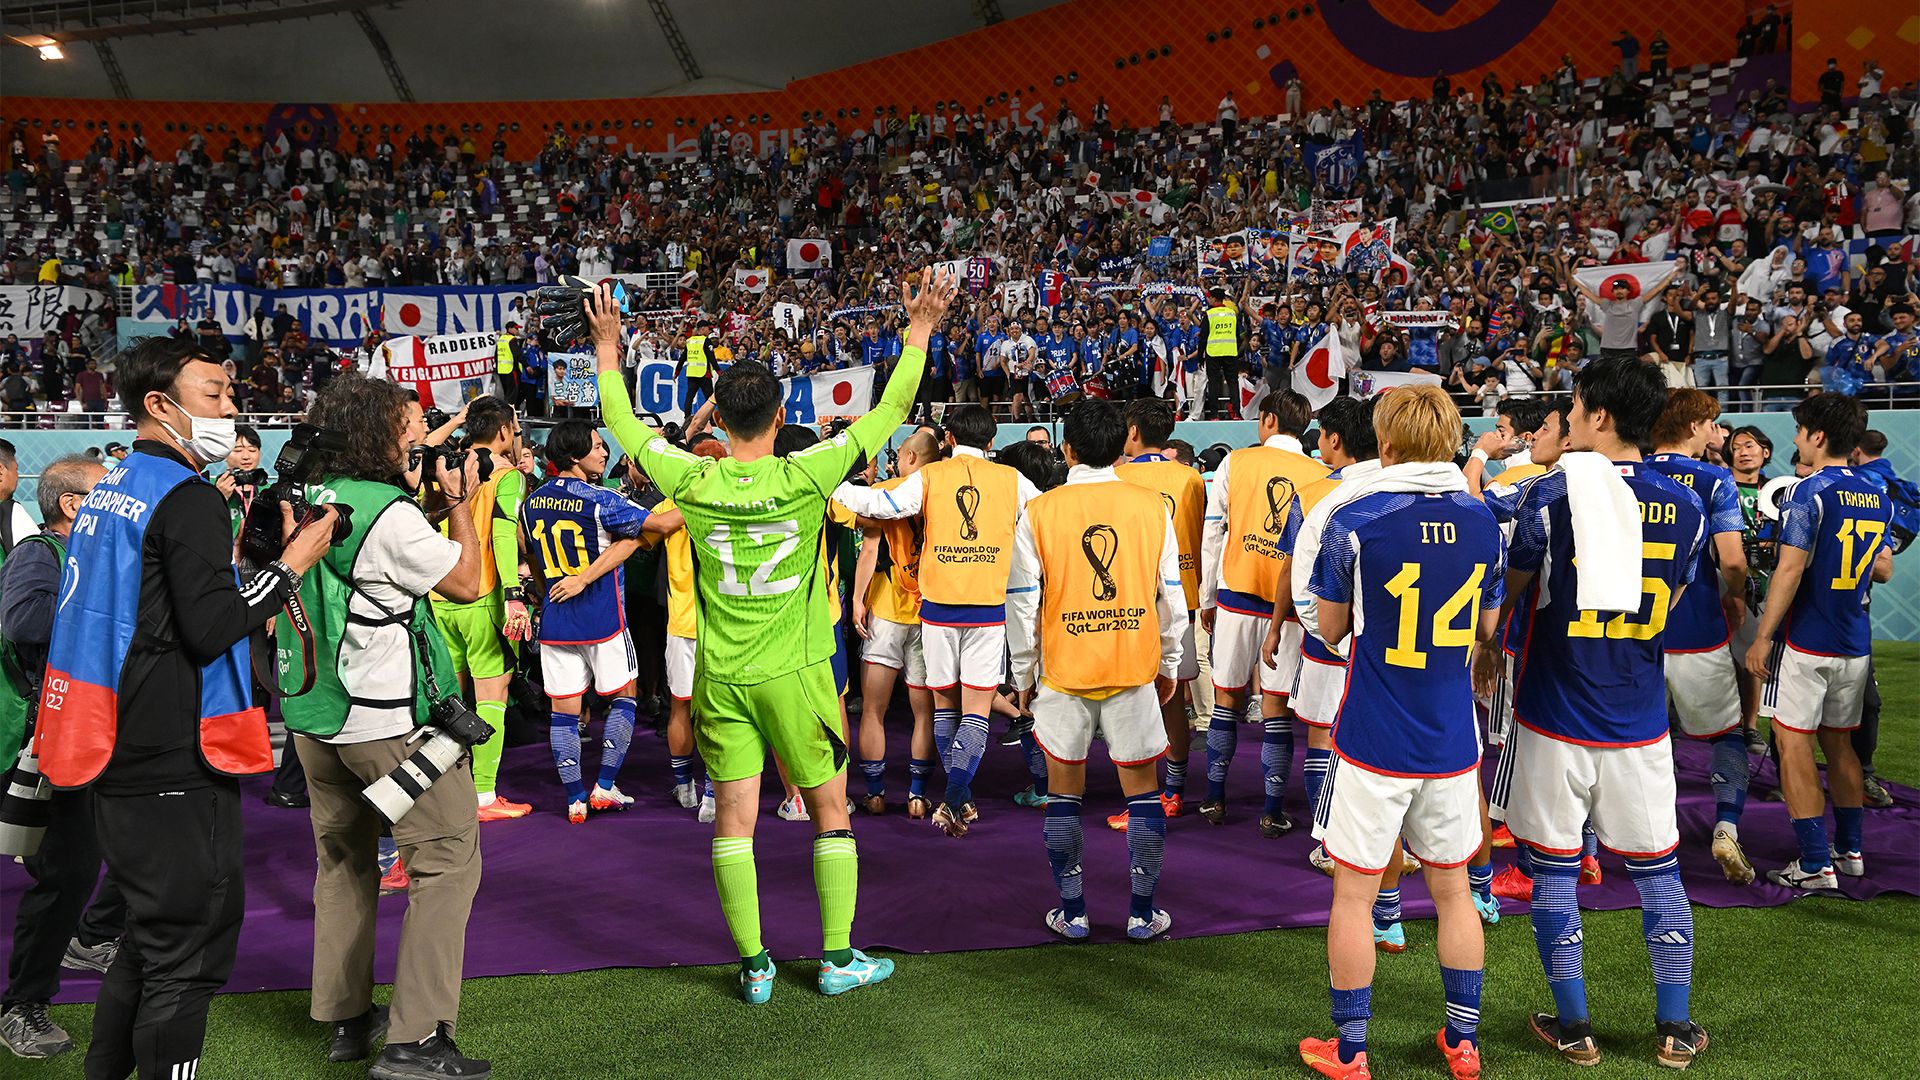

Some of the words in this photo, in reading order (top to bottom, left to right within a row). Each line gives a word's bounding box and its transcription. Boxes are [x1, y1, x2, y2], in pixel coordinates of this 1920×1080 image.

[969, 264, 985, 279] 50
[1044, 274, 1055, 287] 5
[784, 308, 792, 318] 8
[428, 334, 496, 355] RADDERS
[989, 348, 998, 356] 12
[401, 364, 460, 381] ENGLAND
[81, 489, 147, 523] OGRAPHER
[530, 496, 583, 512] MINAMINO
[1836, 491, 1880, 509] TANAKA
[74, 513, 99, 536] JPN
[1419, 521, 1457, 544] ITO
[532, 519, 590, 579] 10
[934, 545, 953, 554] FIFA
[954, 545, 985, 554] WORLD
[986, 546, 1001, 554] CUP
[1258, 537, 1278, 549] WORL
[704, 519, 800, 596] 12
[1831, 518, 1886, 590] 17
[1062, 612, 1085, 622] FIFA
[1086, 608, 1126, 620] WORLD
[1127, 608, 1146, 618] CUP
[1383, 562, 1487, 669] 14
